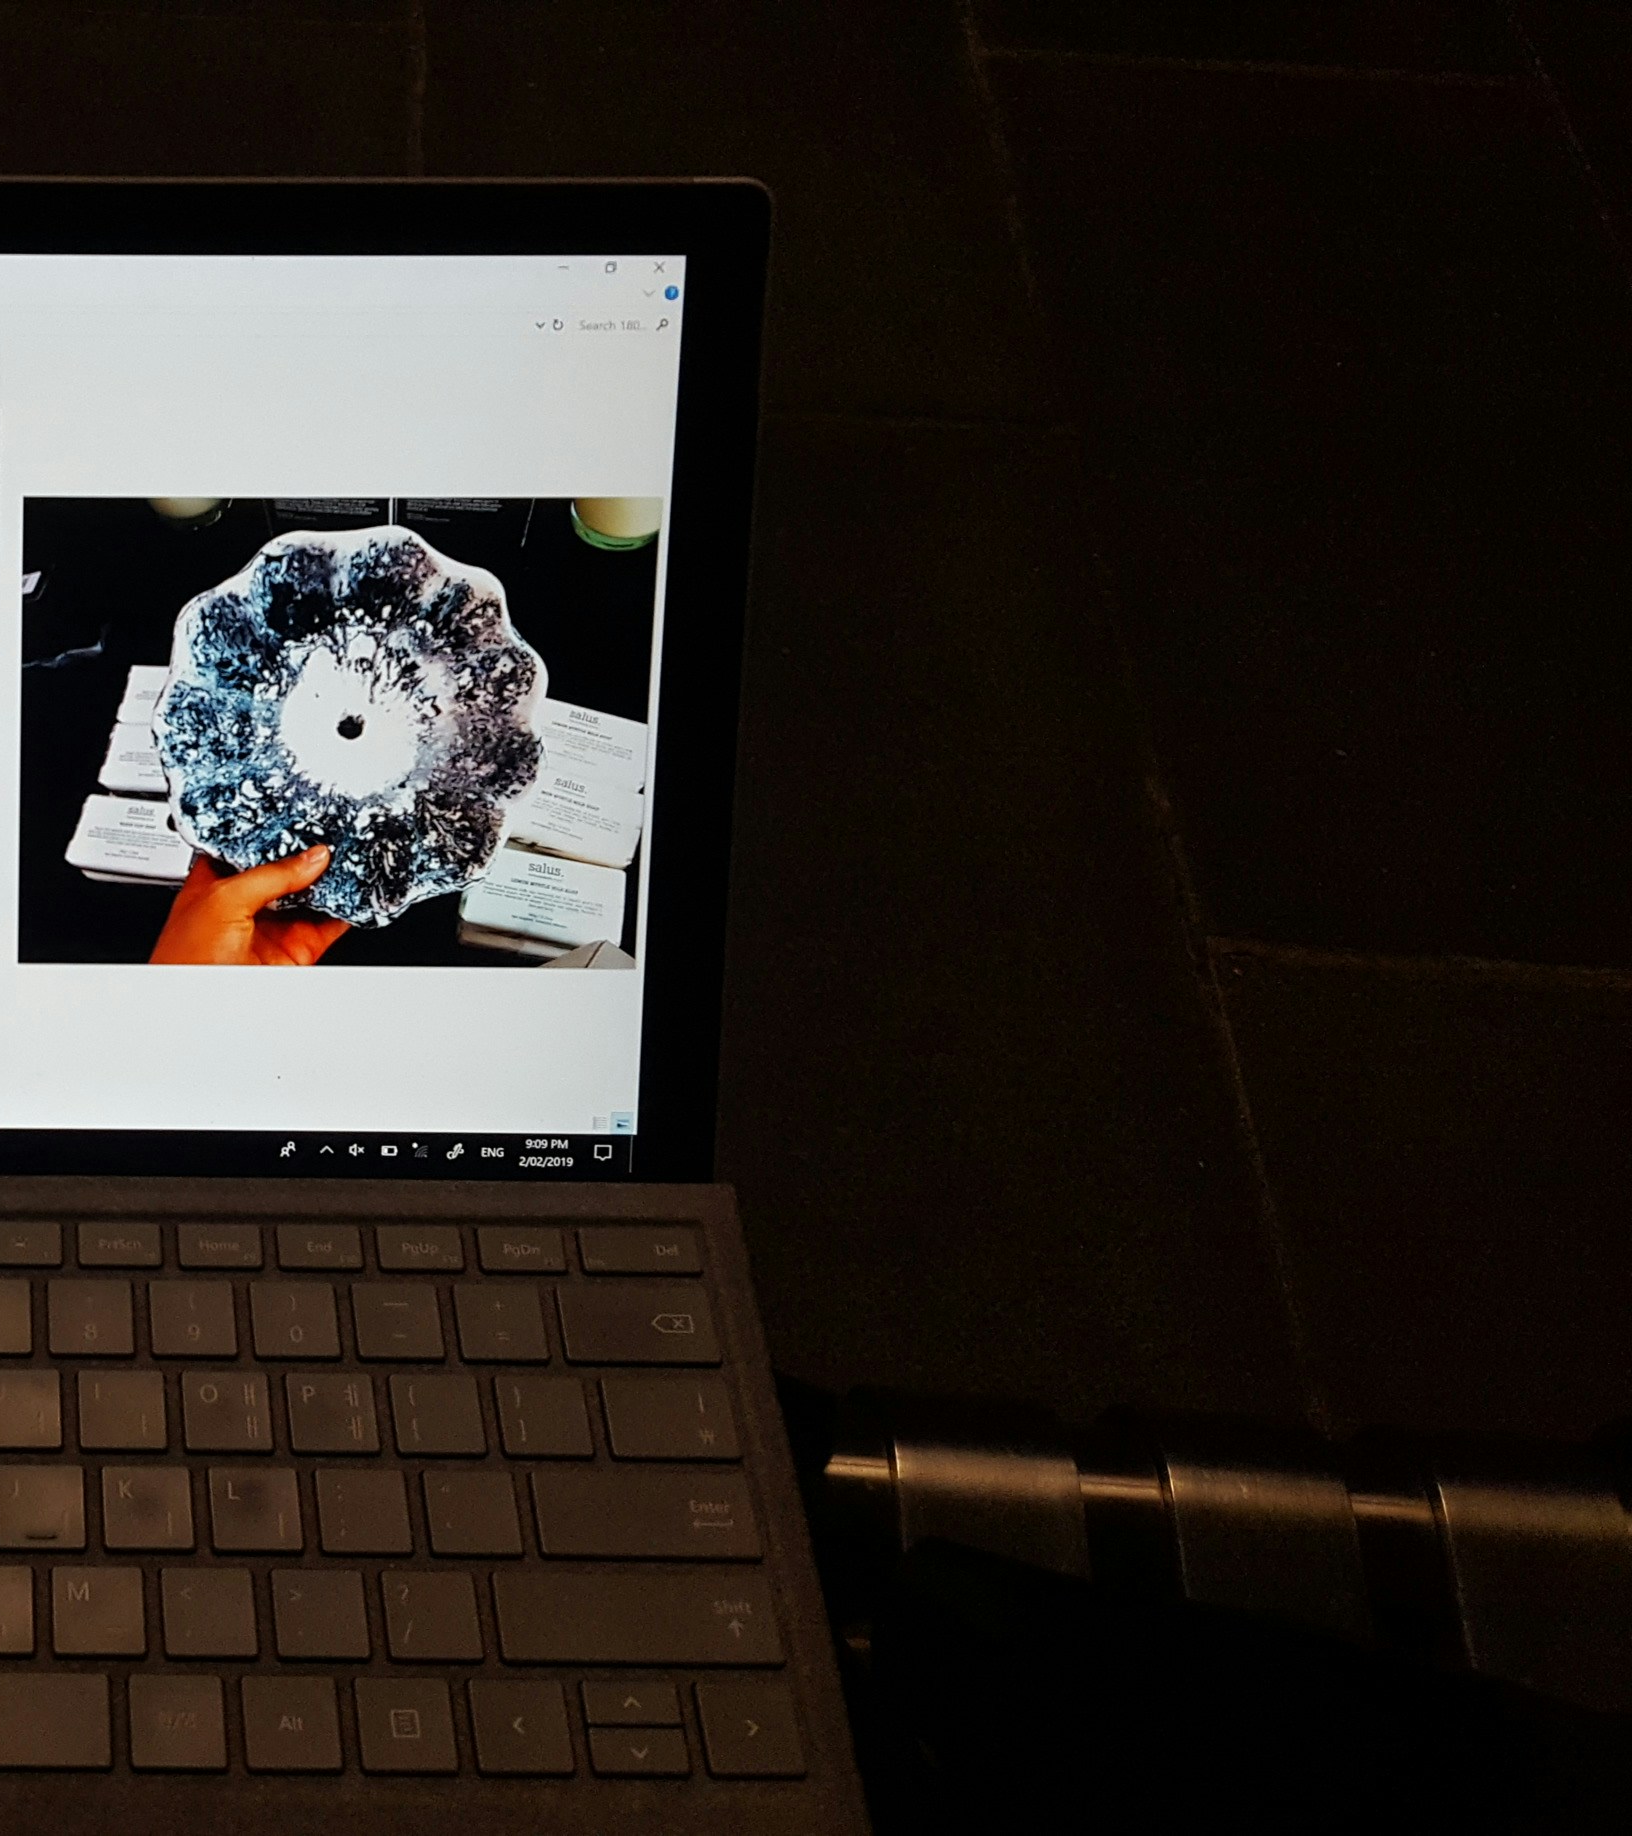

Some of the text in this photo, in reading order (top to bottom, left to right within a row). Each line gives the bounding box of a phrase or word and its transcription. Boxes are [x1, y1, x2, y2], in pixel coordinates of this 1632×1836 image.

[579, 320, 616, 331] Search
[528, 862, 564, 877] salus.
[525, 1138, 569, 1149] 9:09 PM
[480, 1147, 504, 1157] ENG
[518, 1156, 573, 1167] 2/02/2019
[200, 1239, 240, 1251] Home
[307, 1241, 332, 1253] End
[401, 1242, 439, 1255] PgUp
[503, 1243, 541, 1257] PgDn
[655, 1245, 679, 1256] Del
[84, 1323, 98, 1341] 8
[188, 1323, 200, 1341] 9
[290, 1325, 304, 1344] 0
[199, 1384, 219, 1403] O
[302, 1385, 316, 1404] P
[118, 1479, 133, 1499] K
[228, 1480, 241, 1500] L
[689, 1500, 730, 1515] Enter
[67, 1582, 90, 1602] M
[712, 1600, 753, 1616] Shift
[279, 1715, 304, 1732] Alt
